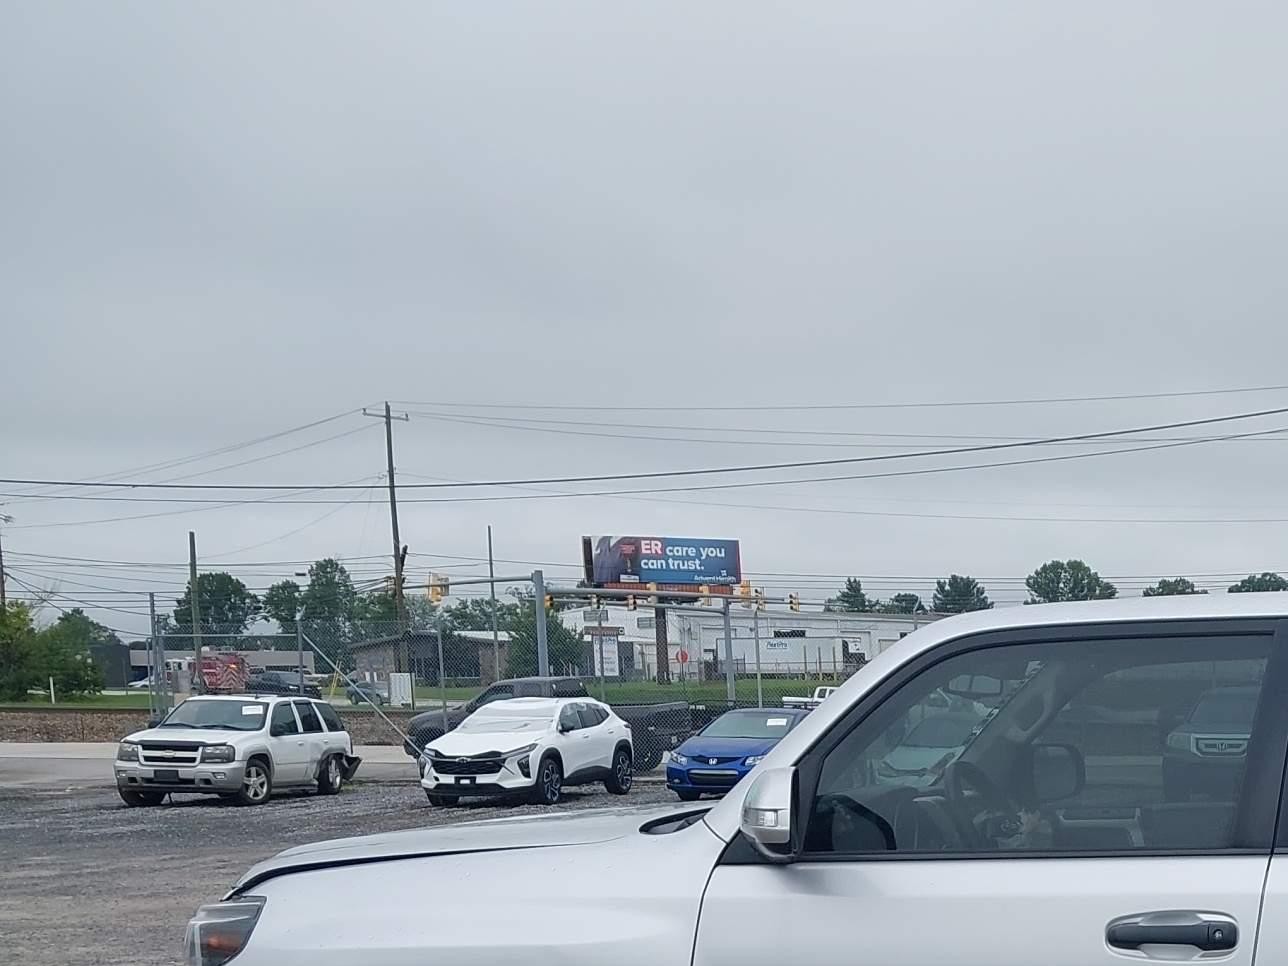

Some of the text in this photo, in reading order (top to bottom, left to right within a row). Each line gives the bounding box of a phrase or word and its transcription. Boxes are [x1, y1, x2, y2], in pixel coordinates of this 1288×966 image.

[641, 540, 662, 554] ER
[666, 546, 696, 556] care
[700, 547, 725, 559] you
[641, 558, 704, 570] can trust.
